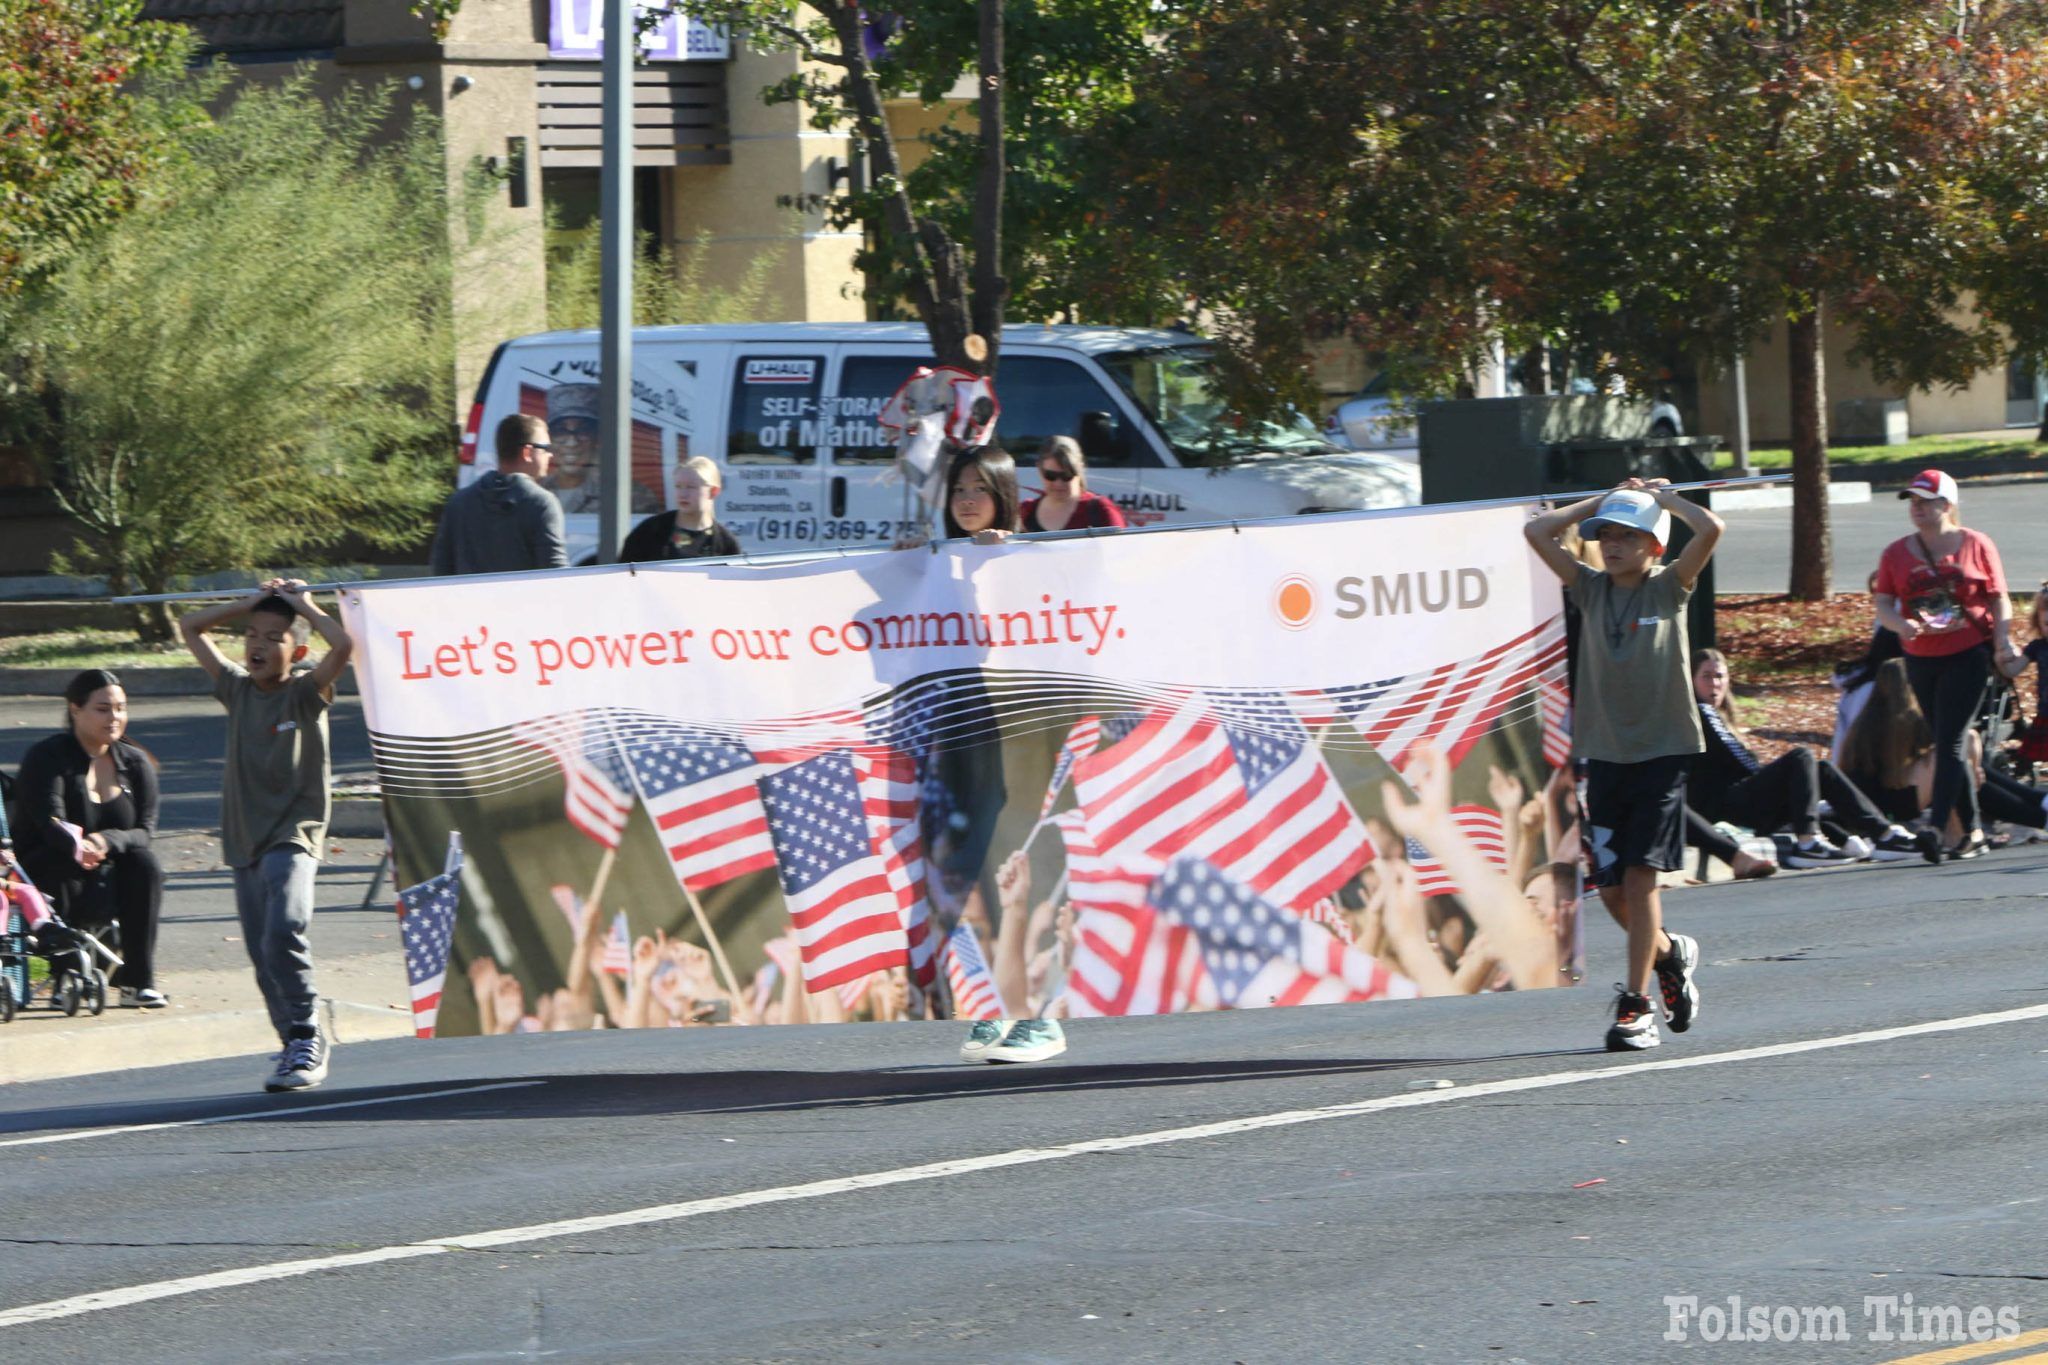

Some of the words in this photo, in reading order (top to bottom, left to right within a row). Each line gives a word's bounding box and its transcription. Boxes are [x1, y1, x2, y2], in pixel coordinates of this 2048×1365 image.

[749, 363, 811, 375] U-HAUL
[761, 397, 894, 416] SELF-STORA
[758, 419, 791, 447] of
[798, 419, 902, 447] Mathe
[1108, 493, 1187, 511] -HAUL
[757, 516, 817, 542] (916)
[1334, 567, 1489, 619] SMUD
[396, 626, 518, 680] Let's
[530, 628, 694, 685] power
[711, 627, 792, 661] our
[808, 593, 1125, 656] community.
